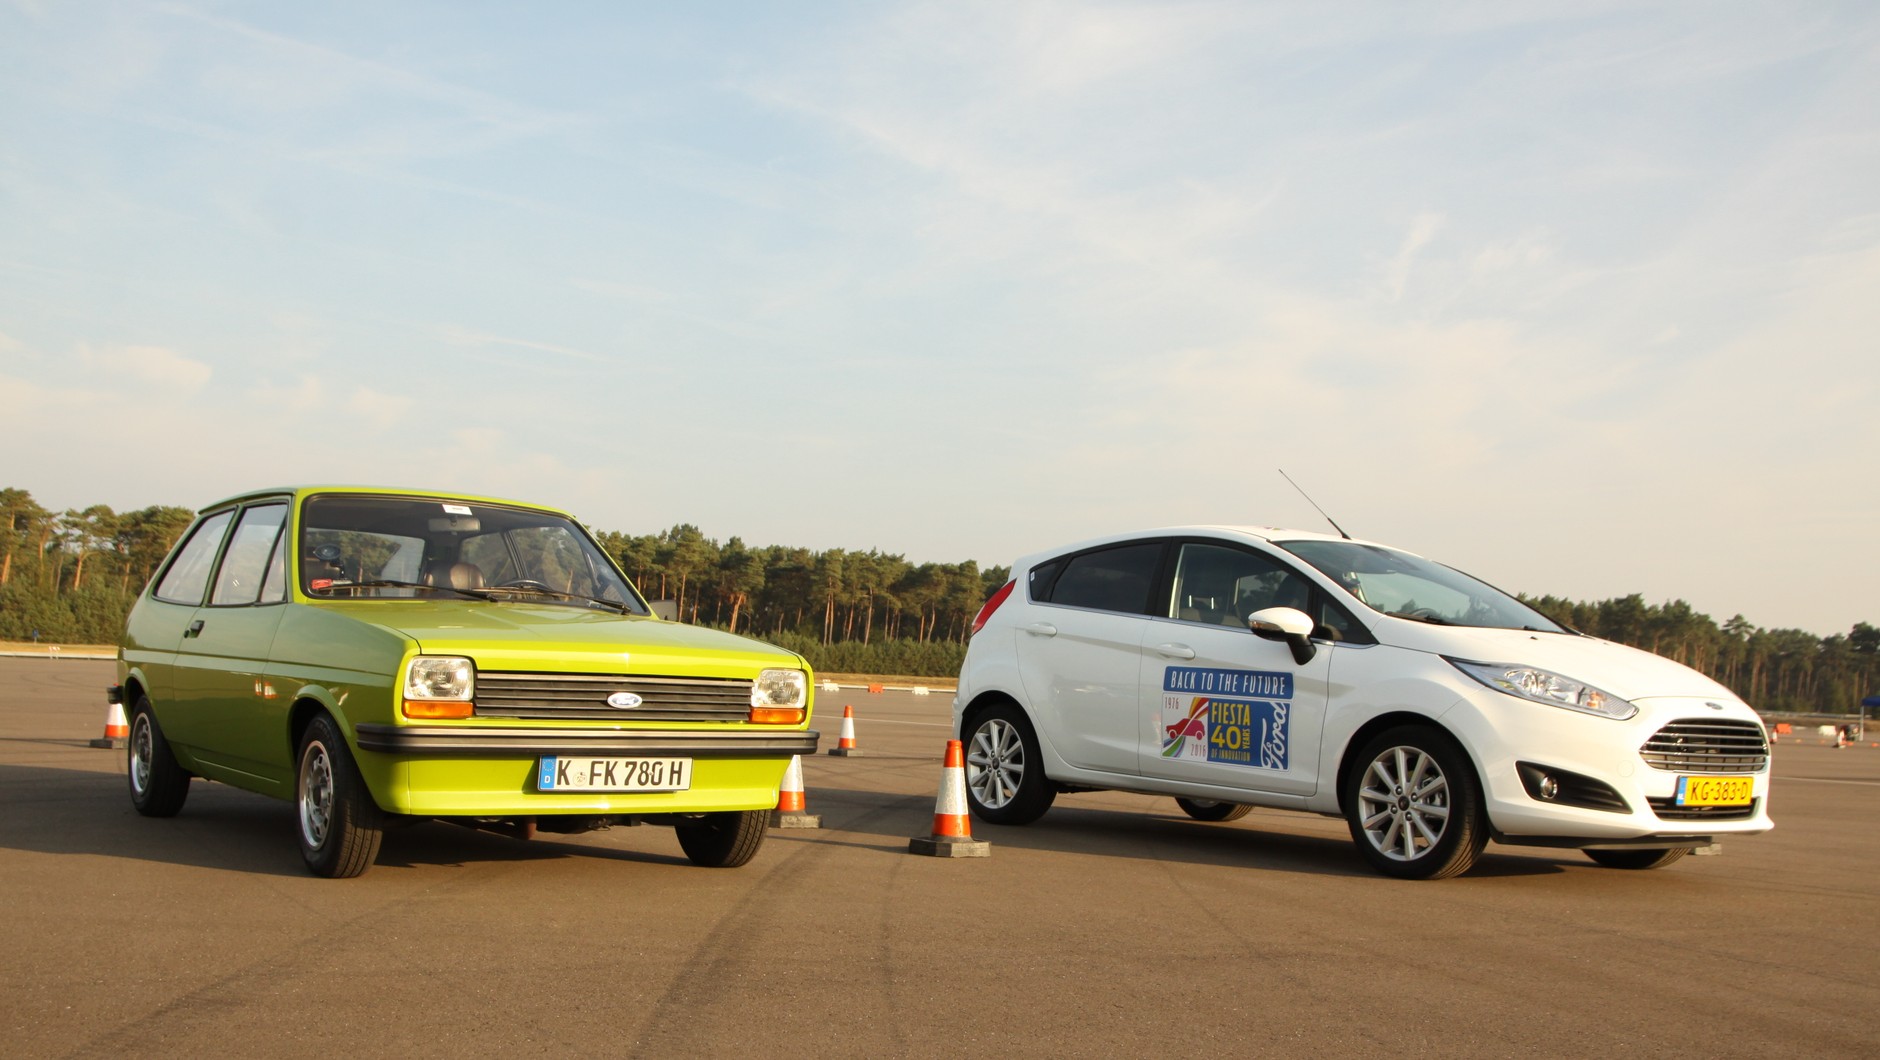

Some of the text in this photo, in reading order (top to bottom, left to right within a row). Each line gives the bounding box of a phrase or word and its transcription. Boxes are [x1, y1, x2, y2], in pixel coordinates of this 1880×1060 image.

[1170, 671, 1285, 695] BACK TO THE FUTURE
[1165, 697, 1179, 710] 1976
[1211, 702, 1250, 726] FIESTA
[1210, 725, 1241, 750] 40
[1242, 728, 1250, 749] YEARS
[1261, 701, 1287, 770] Ford
[1190, 744, 1206, 757] 2016
[1211, 748, 1250, 762] OF INNOVATION
[544, 776, 551, 784] D
[556, 760, 683, 786] K FK 780 H
[1691, 782, 1748, 800] KG-383-D
